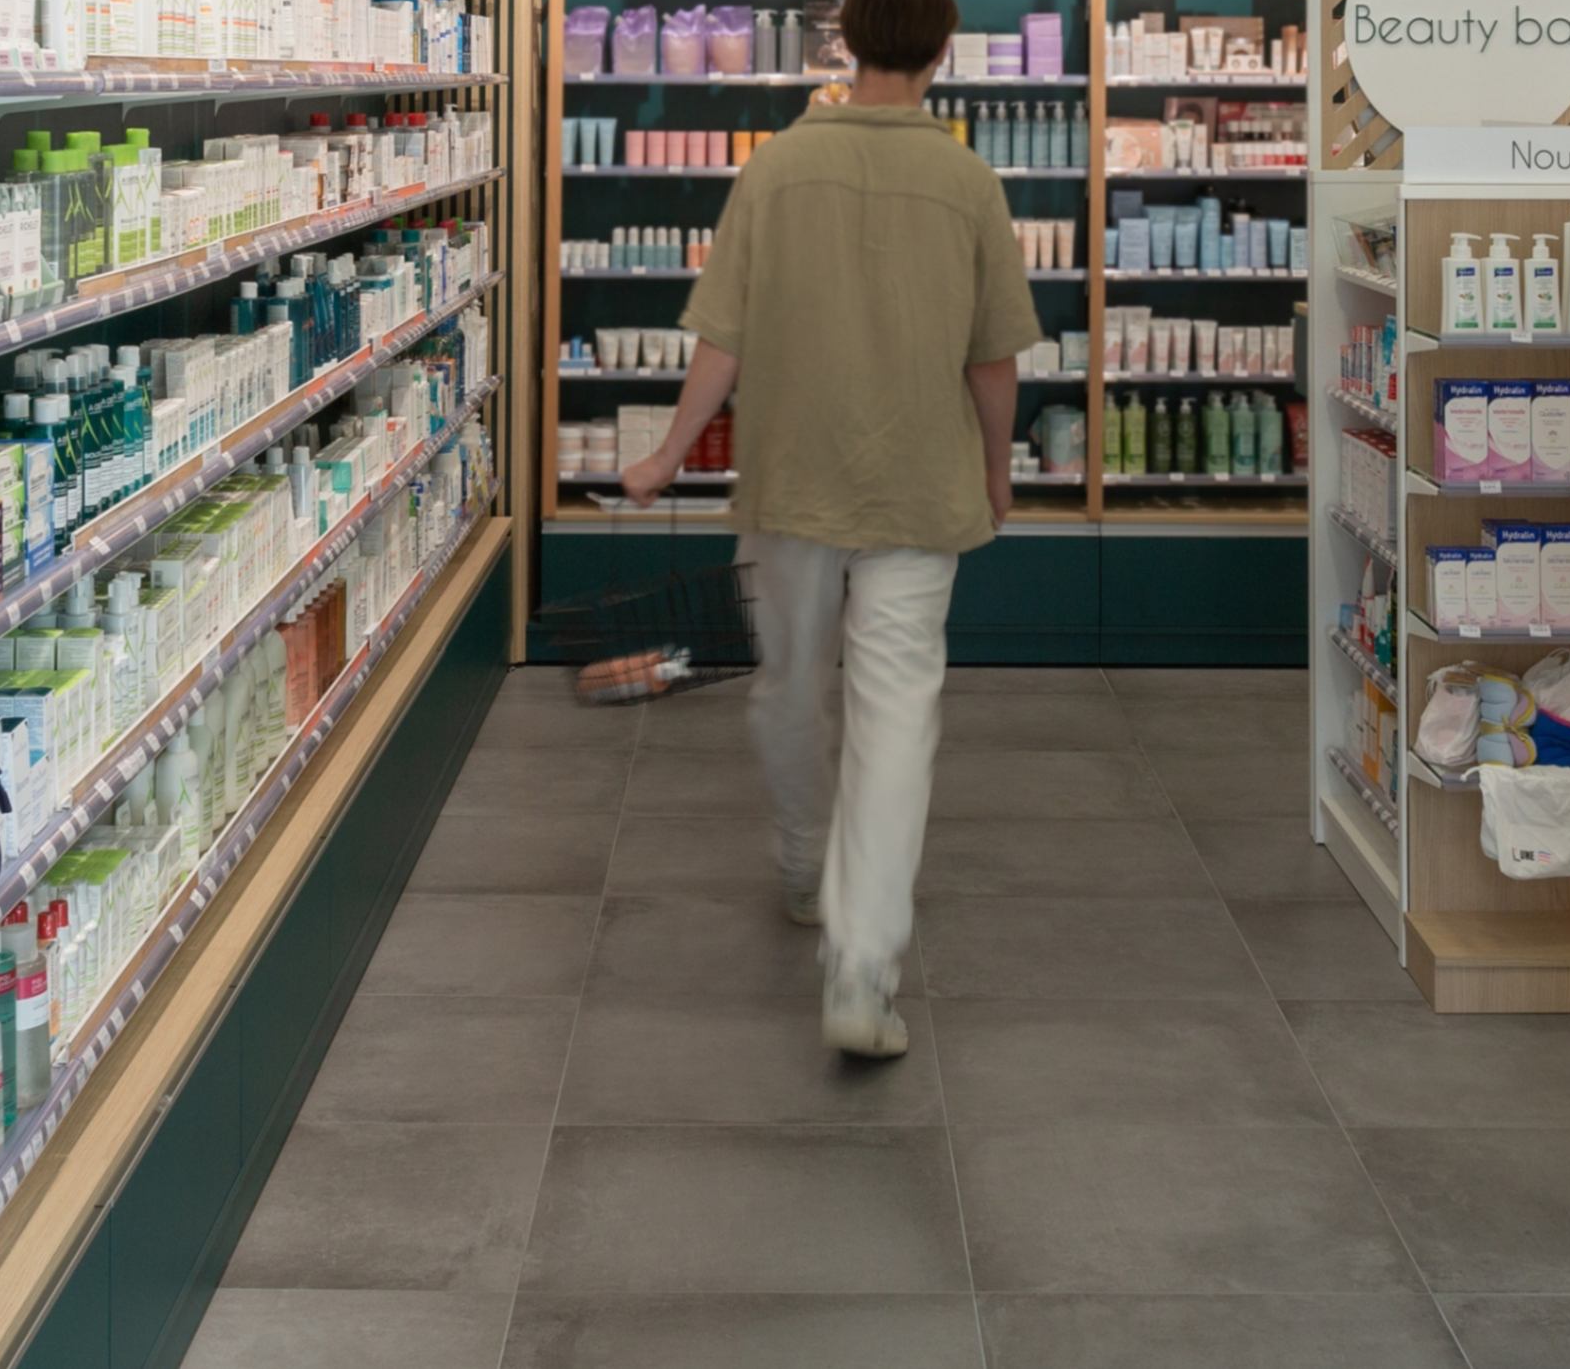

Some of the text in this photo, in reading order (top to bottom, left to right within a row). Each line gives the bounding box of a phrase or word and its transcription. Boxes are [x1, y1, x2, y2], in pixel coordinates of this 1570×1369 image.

[1354, 3, 1498, 54] Beauty
[1450, 385, 1483, 398] Hydralin
[1493, 385, 1526, 398] Hydralin
[1536, 383, 1569, 396] Hydralin
[1501, 529, 1536, 544] Hydralin
